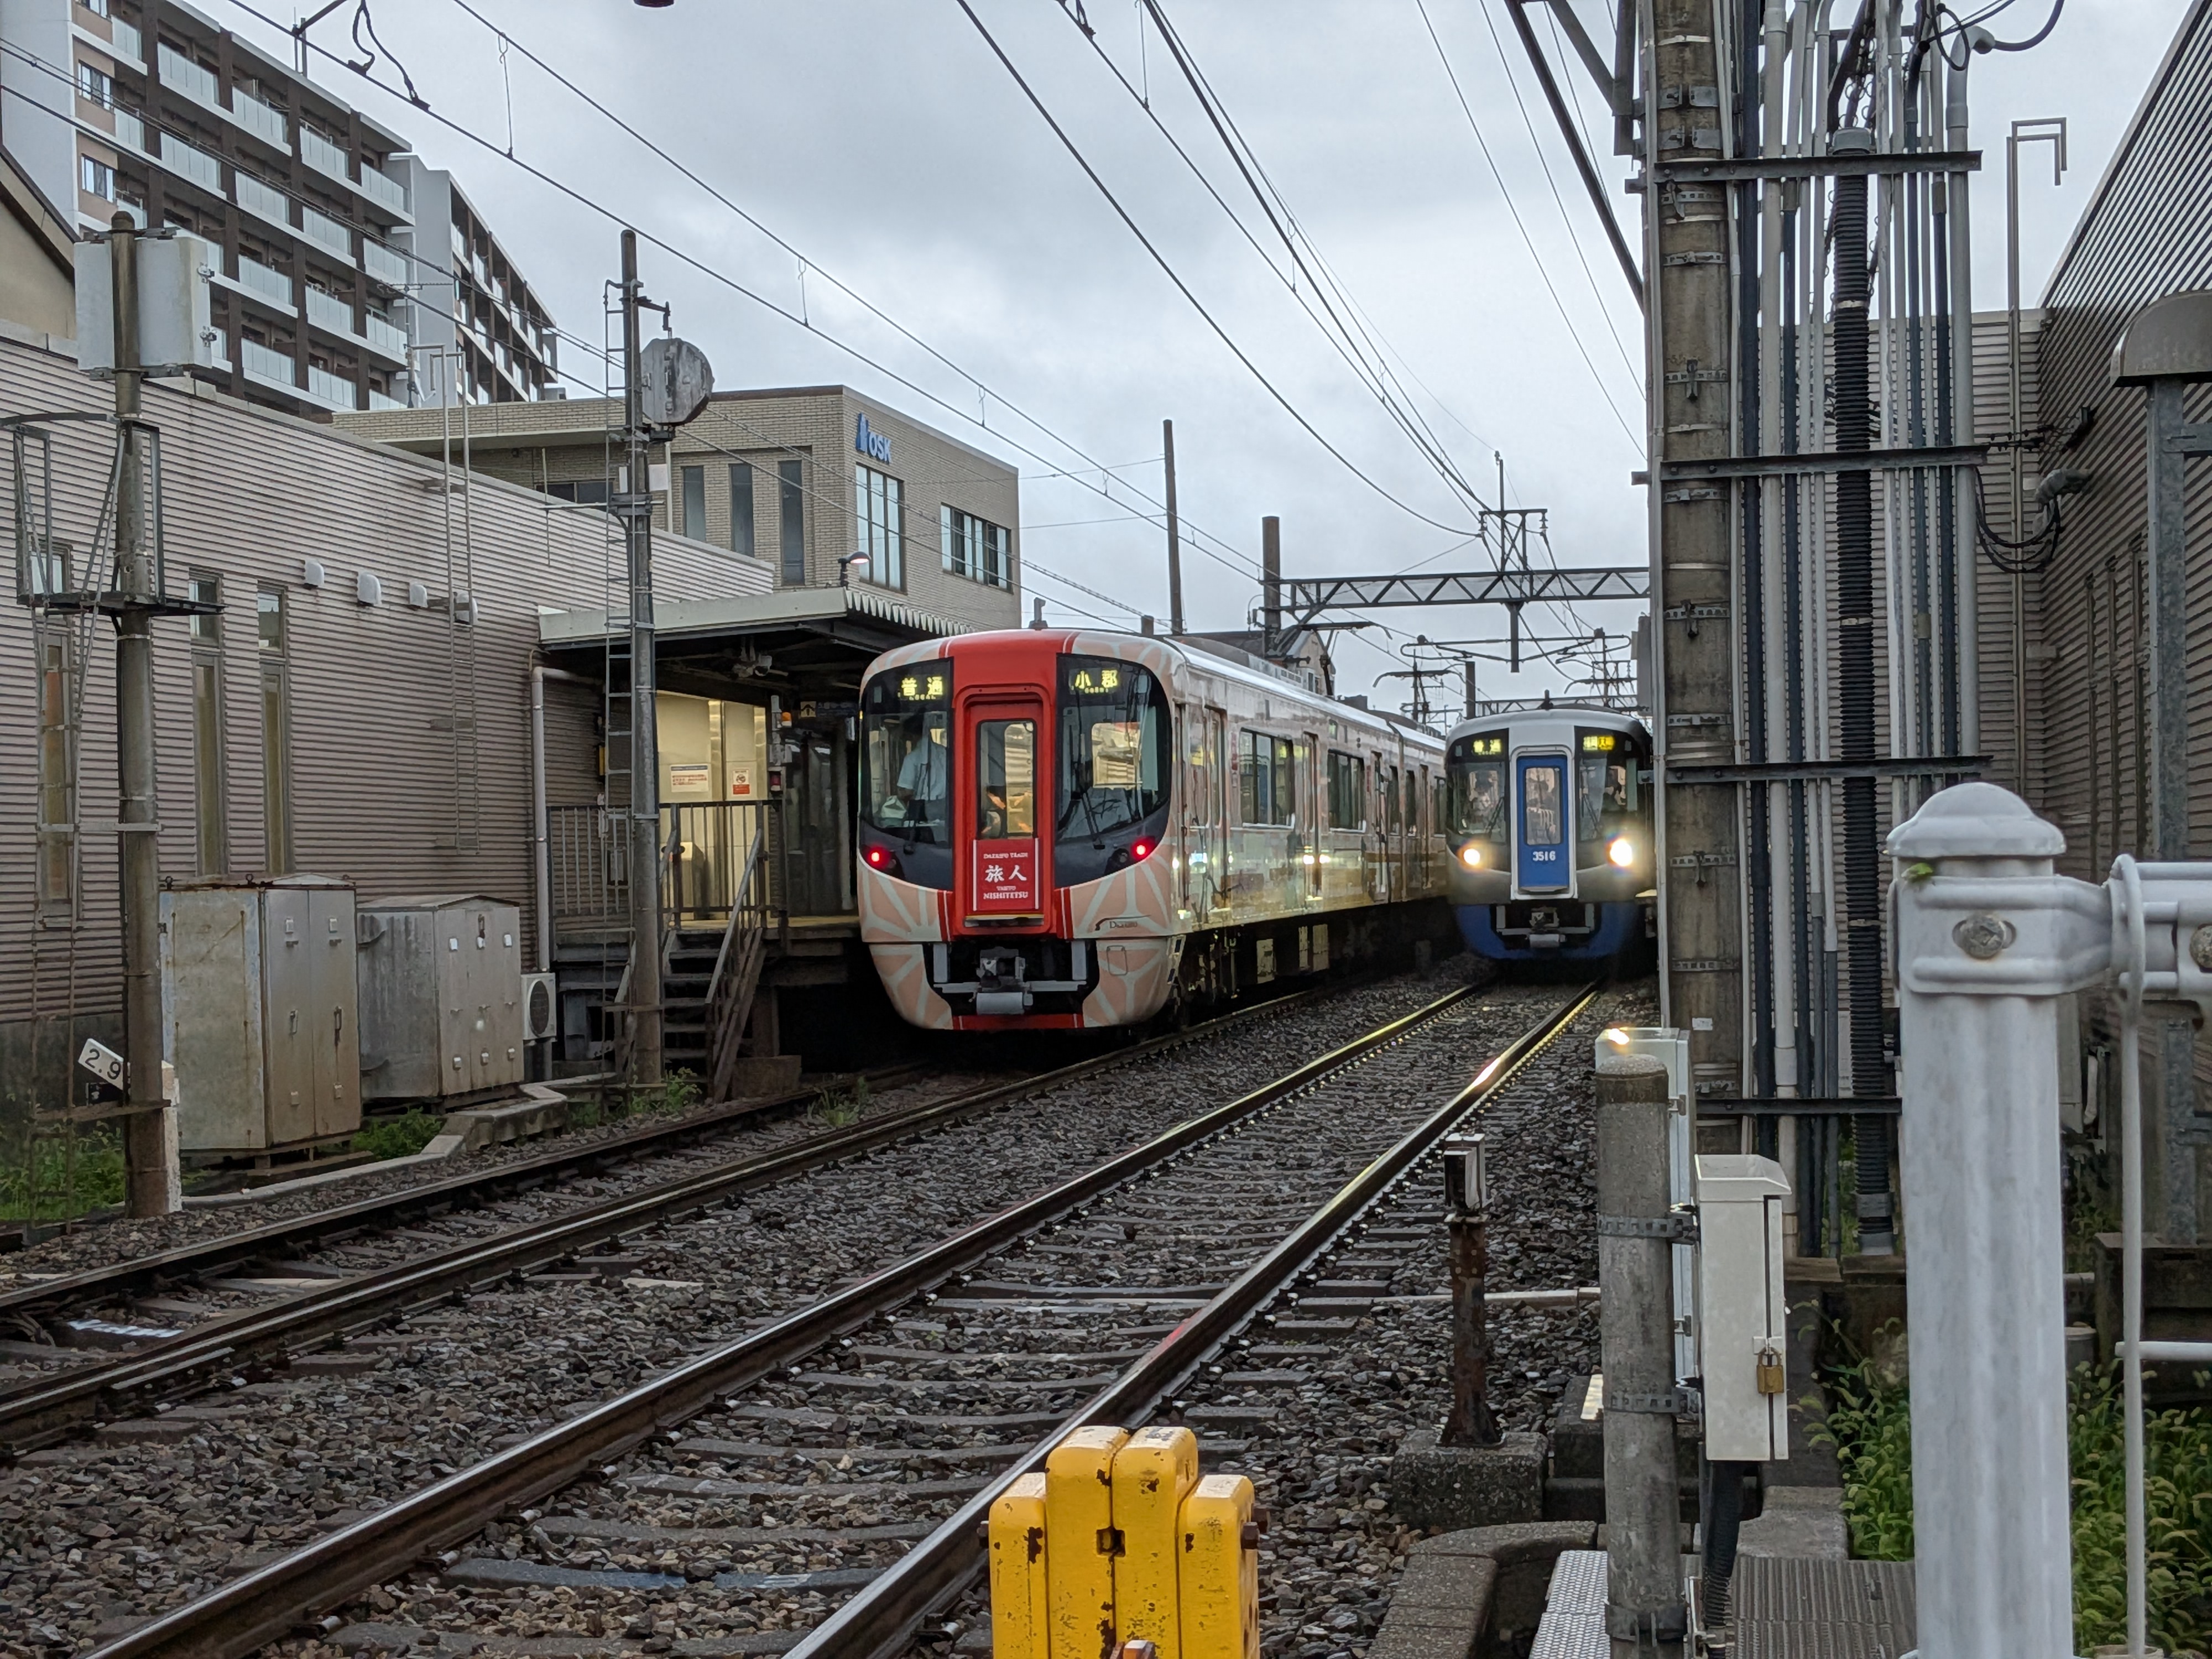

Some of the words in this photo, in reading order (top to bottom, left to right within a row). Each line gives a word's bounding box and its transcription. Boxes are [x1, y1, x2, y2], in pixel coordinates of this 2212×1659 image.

[868, 431, 892, 464] OSK
[901, 676, 943, 696] 普通
[1075, 670, 1118, 689] 小郡
[1532, 851, 1556, 861] 3516
[984, 864, 1027, 883] 旅人
[85, 1048, 121, 1079] 2.9
